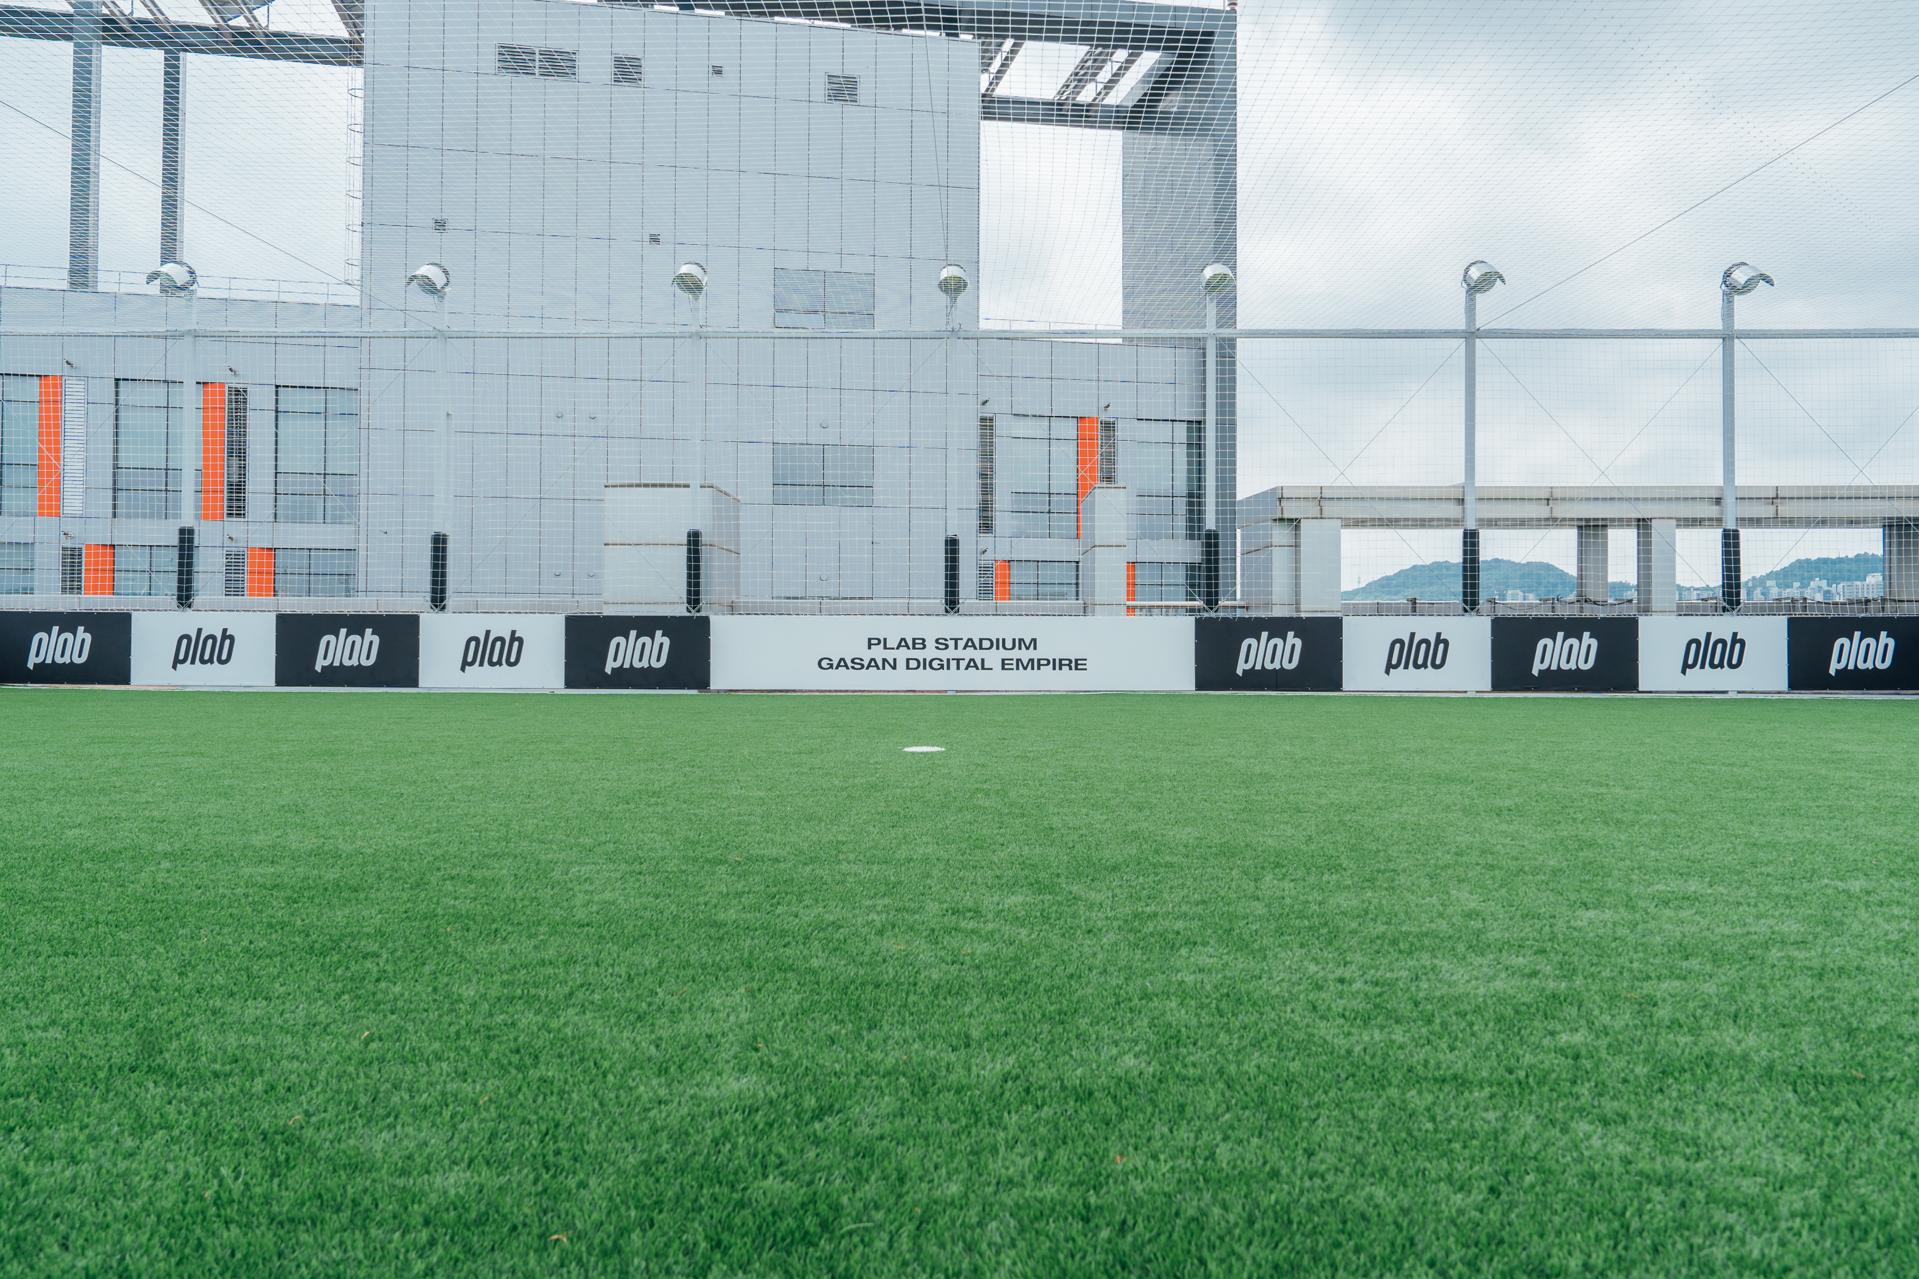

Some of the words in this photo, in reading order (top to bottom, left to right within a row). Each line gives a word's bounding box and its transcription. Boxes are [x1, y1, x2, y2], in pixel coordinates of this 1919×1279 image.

[27, 626, 91, 669] plab
[172, 628, 235, 671] plab
[315, 629, 379, 672] plab
[460, 630, 524, 673] plab
[605, 630, 670, 674] plab
[817, 657, 898, 671] GASAN
[905, 657, 994, 671] DIGITAL
[1000, 657, 1088, 671] EMPIRE
[867, 637, 926, 651] PLAB
[934, 637, 1038, 651] STADIUM
[1237, 632, 1301, 676] plab
[1385, 632, 1449, 676] plab
[1532, 632, 1597, 676] plab
[1681, 632, 1746, 676] plab
[1829, 631, 1894, 676] plab
